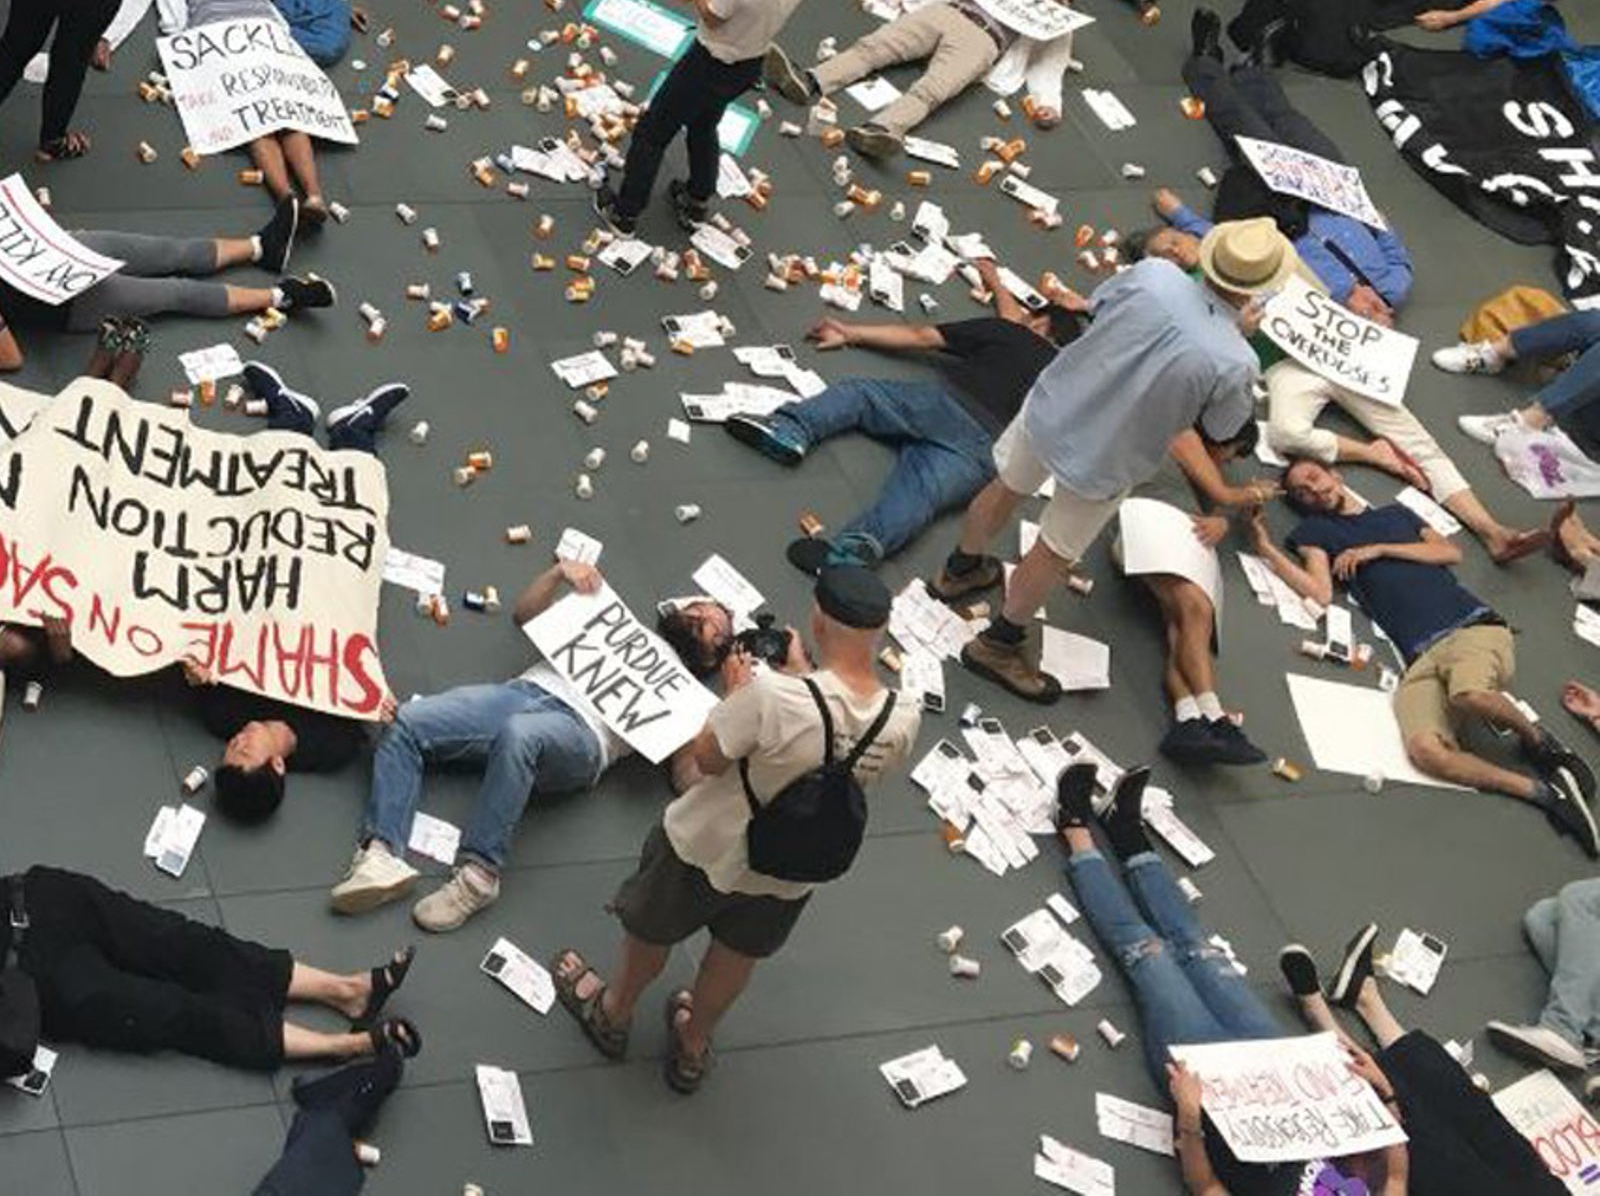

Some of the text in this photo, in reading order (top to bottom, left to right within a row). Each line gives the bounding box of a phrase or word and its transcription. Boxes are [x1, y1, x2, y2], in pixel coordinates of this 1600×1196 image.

[1295, 290, 1384, 347] STOP
[1312, 323, 1352, 355] THE
[55, 396, 378, 517] TREATMENT
[67, 464, 377, 571] REDUCTION
[86, 594, 163, 657] ON
[133, 551, 301, 615] HARM
[183, 619, 384, 714] SHAME
[551, 632, 672, 733] KNEW
[583, 601, 691, 702] PURDUE
